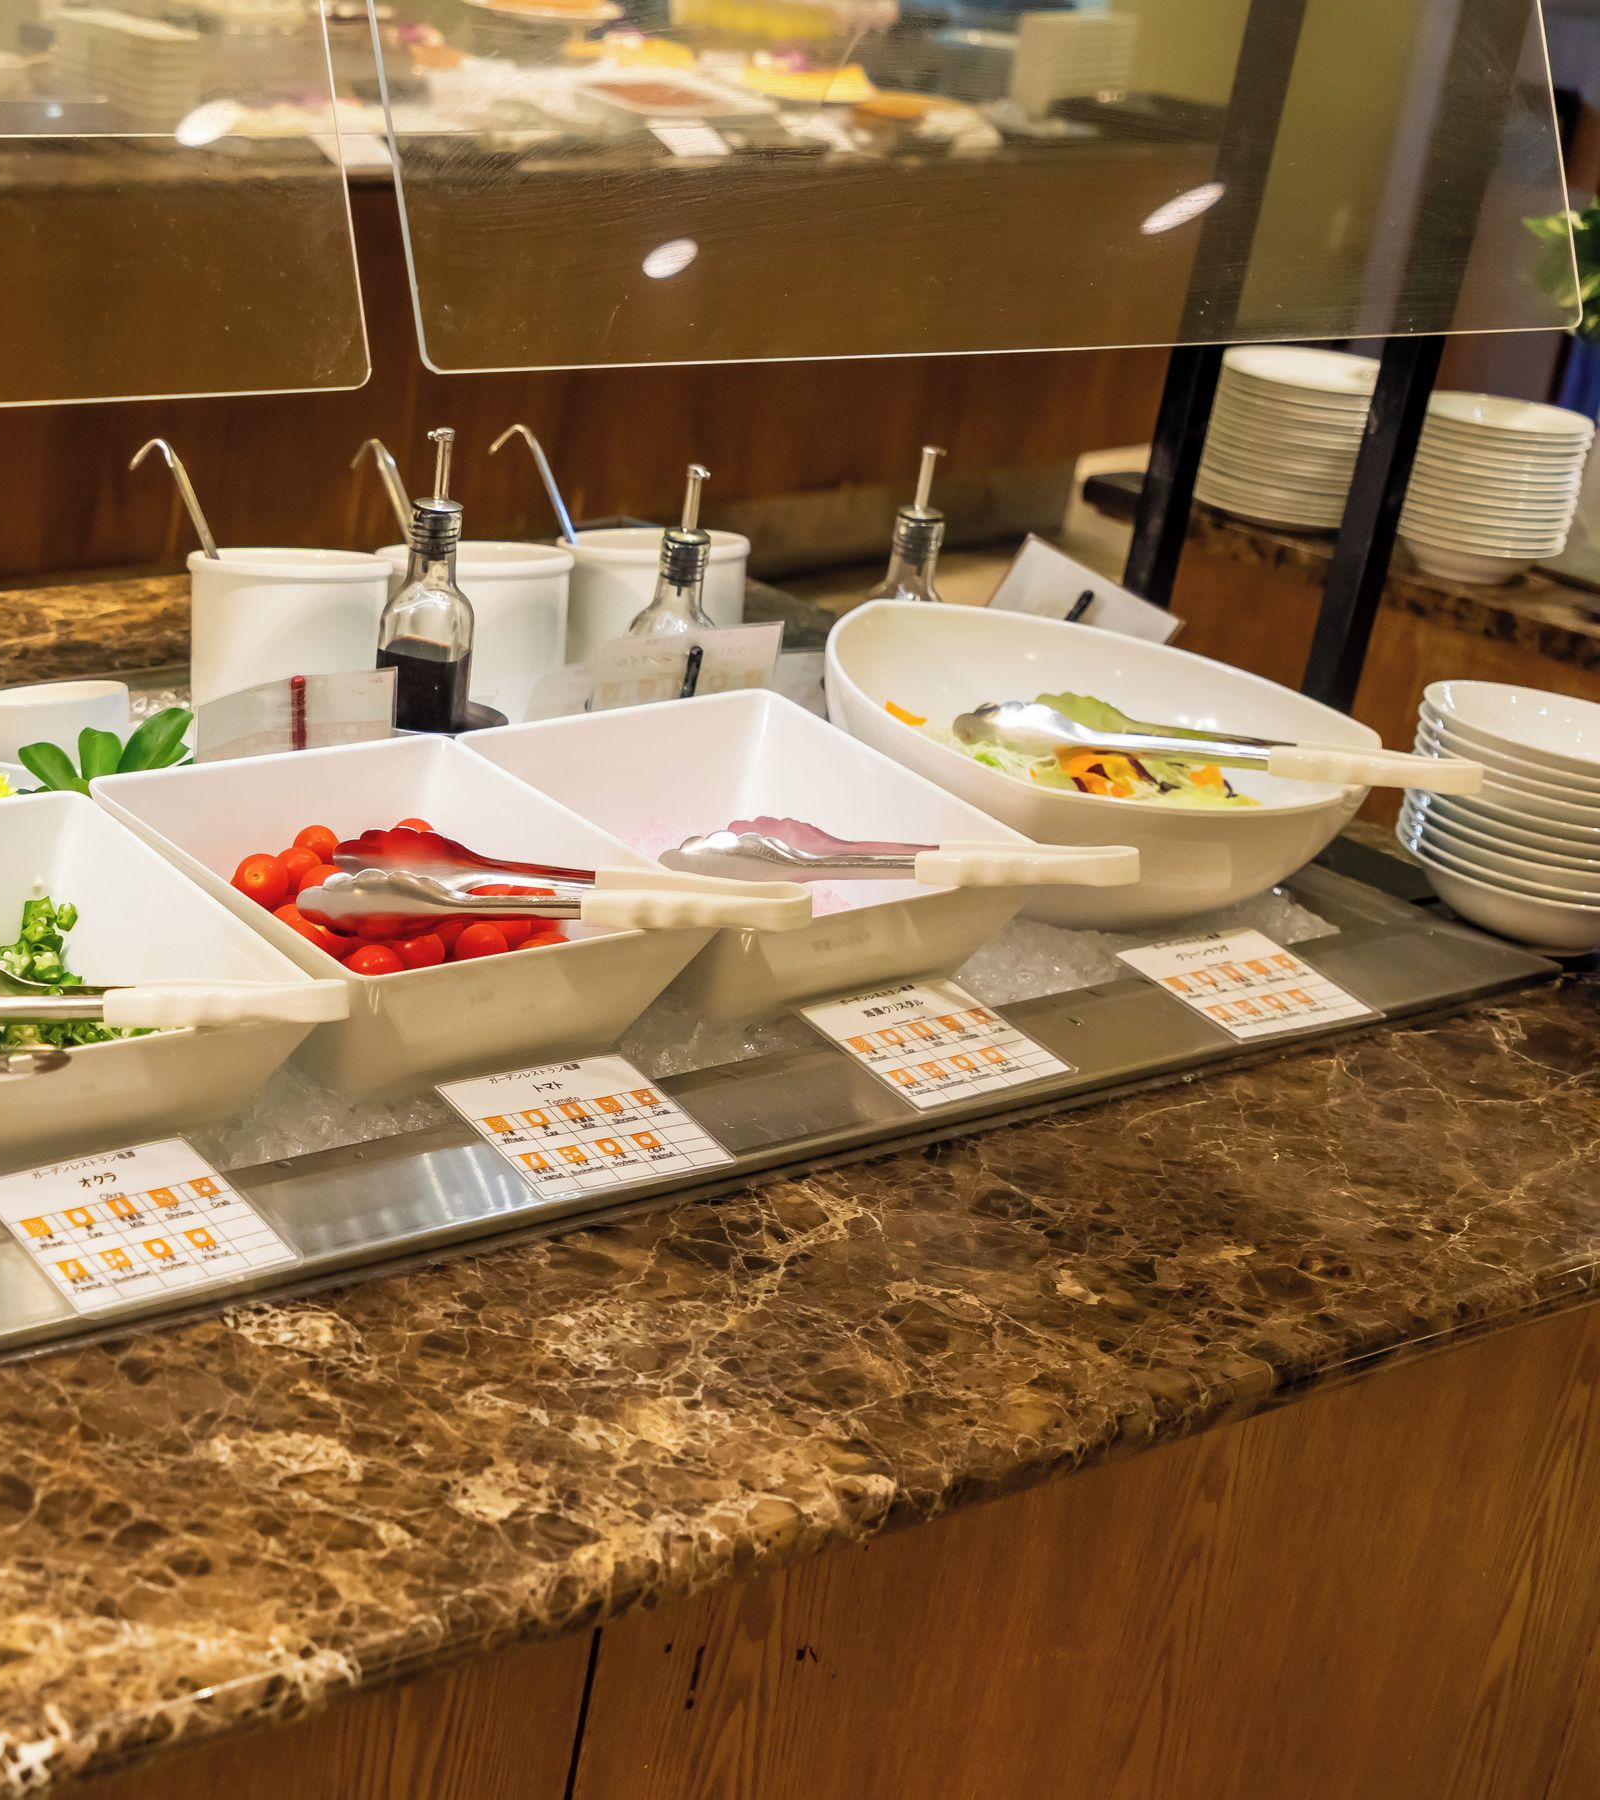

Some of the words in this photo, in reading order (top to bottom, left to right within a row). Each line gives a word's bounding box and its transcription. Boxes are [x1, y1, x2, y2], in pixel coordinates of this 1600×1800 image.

[532, 1080, 564, 1093] トマト
[544, 1096, 581, 1106] Tomato
[651, 1151, 676, 1161] Walnut
[78, 1172, 117, 1189] オクラ
[99, 1191, 126, 1201] Okra
